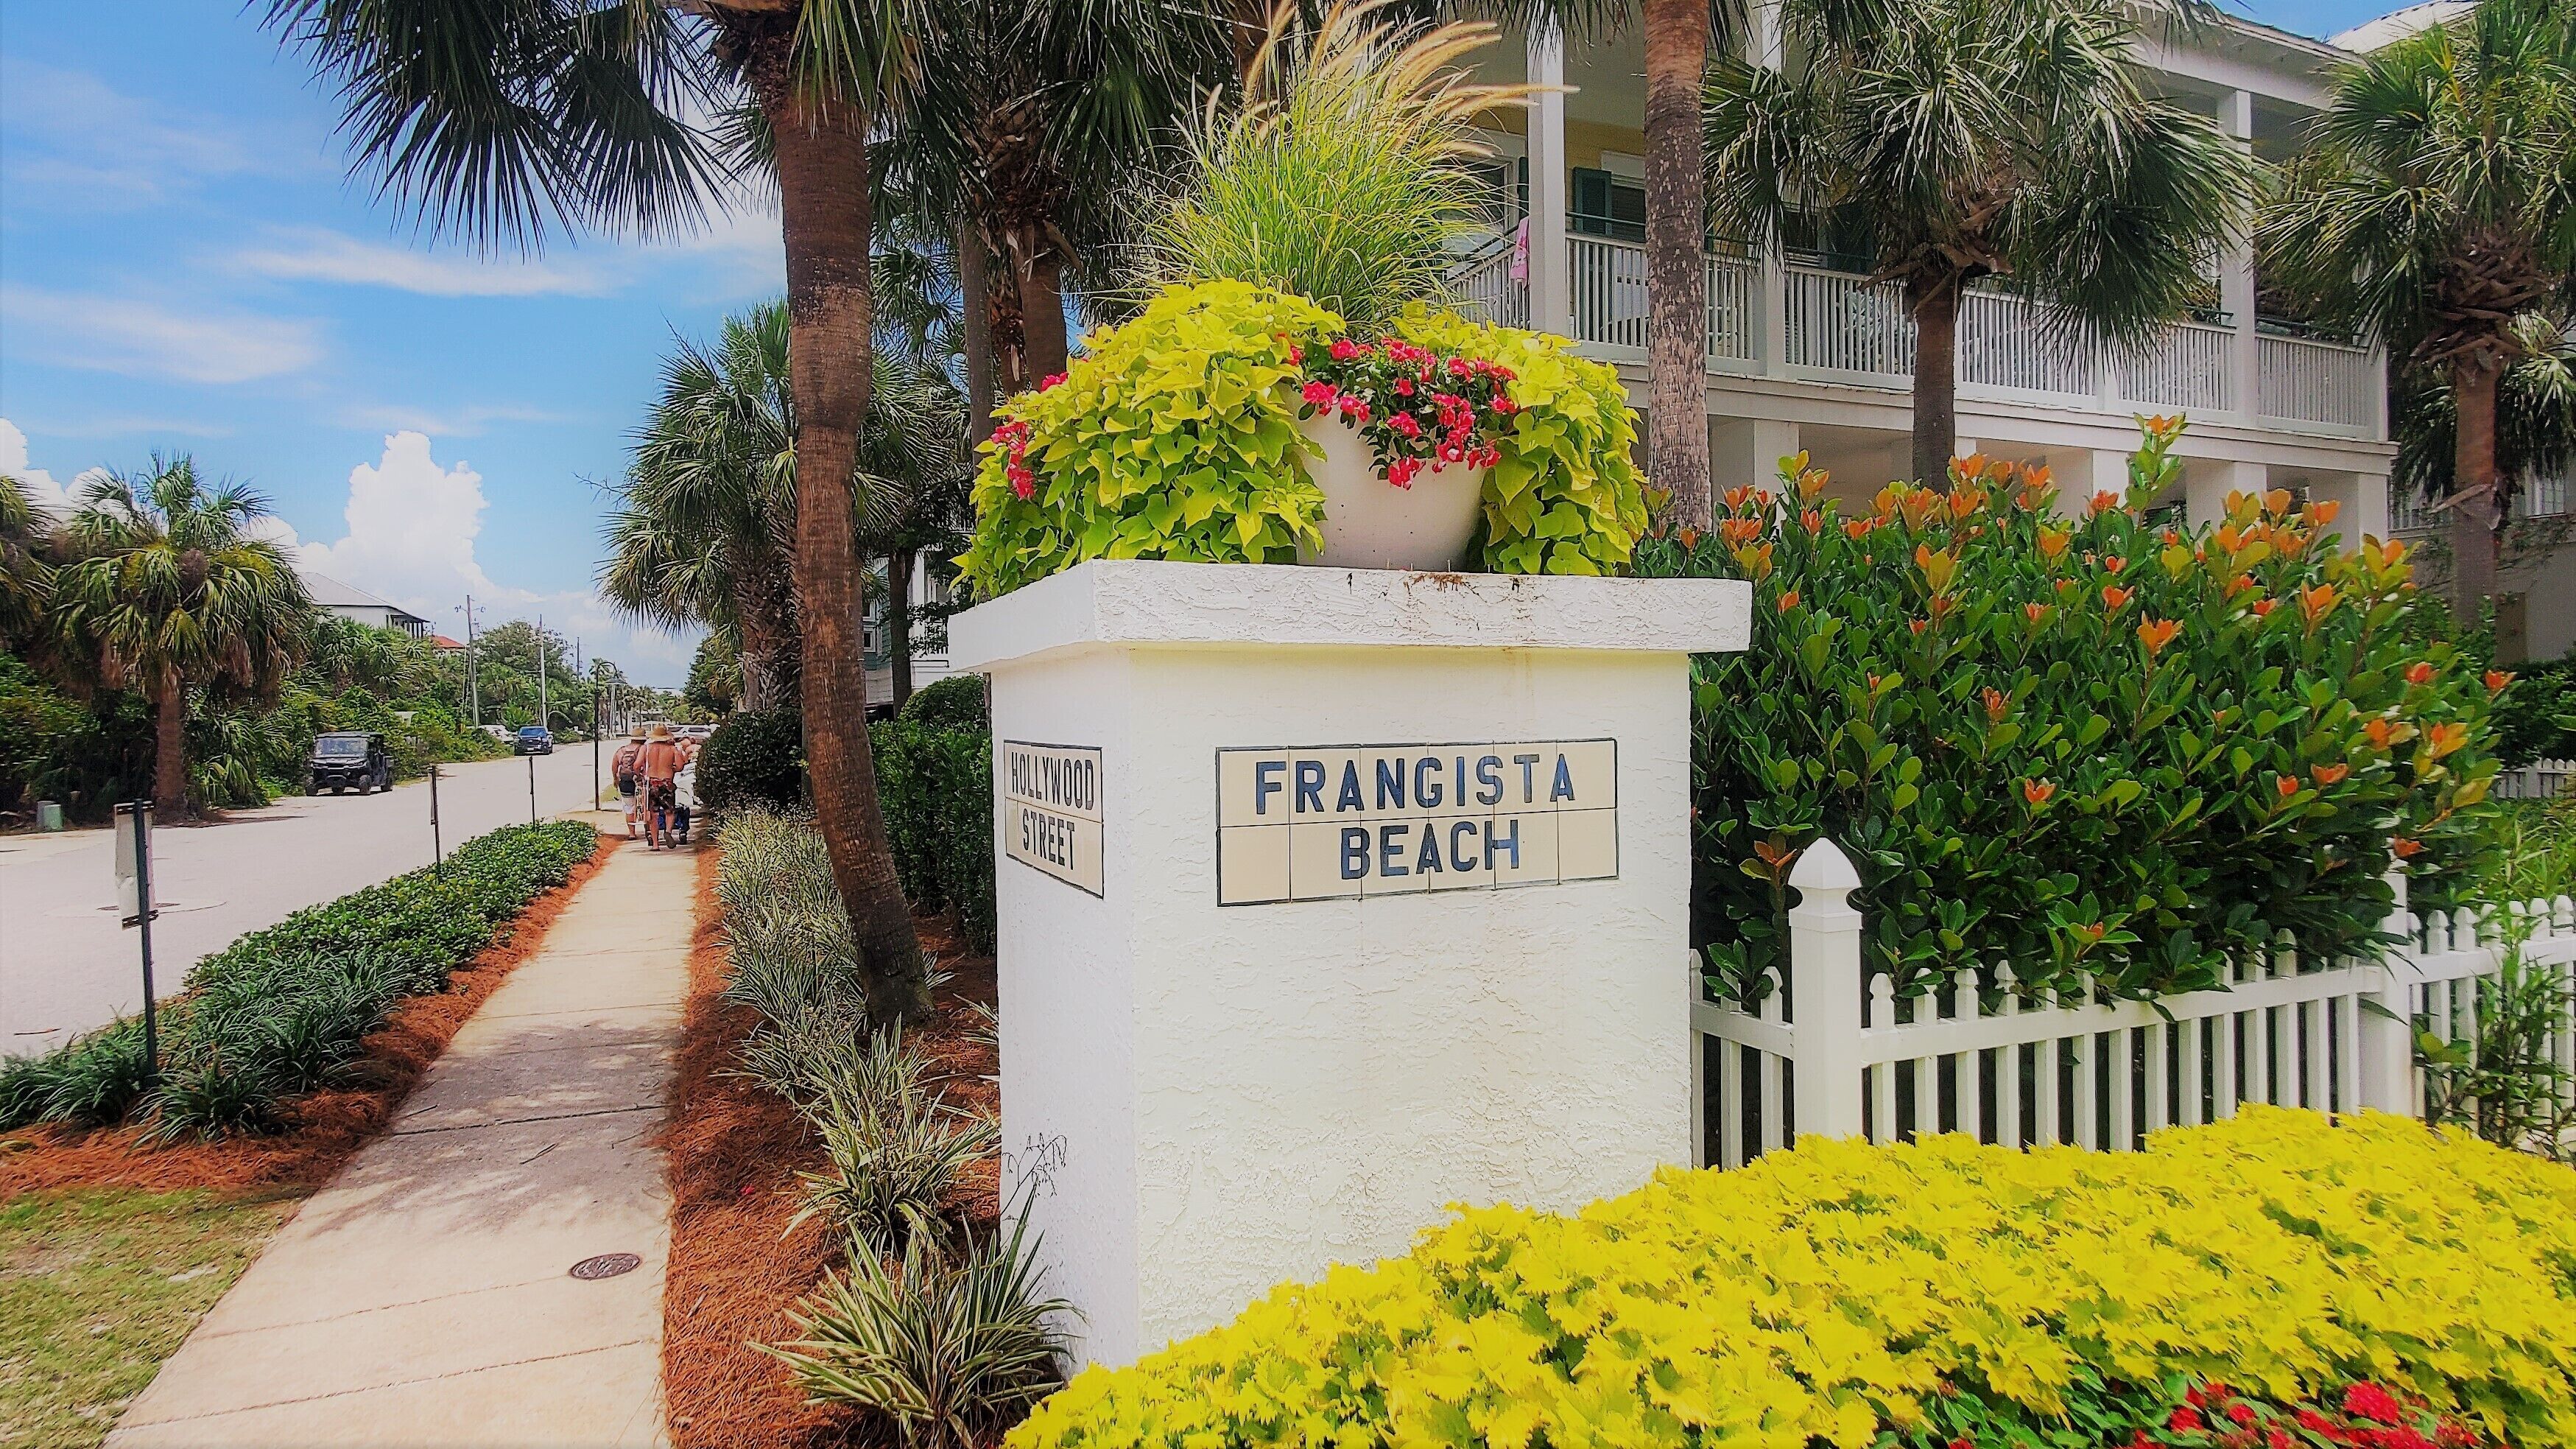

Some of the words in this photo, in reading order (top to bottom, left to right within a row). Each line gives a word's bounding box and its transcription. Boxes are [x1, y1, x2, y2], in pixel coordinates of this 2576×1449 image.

[1011, 751, 1094, 810] HOLLYWOOD
[1256, 754, 1575, 815] FRANGISTA
[1022, 808, 1075, 871] STREET
[1340, 819, 1519, 880] BEACH
